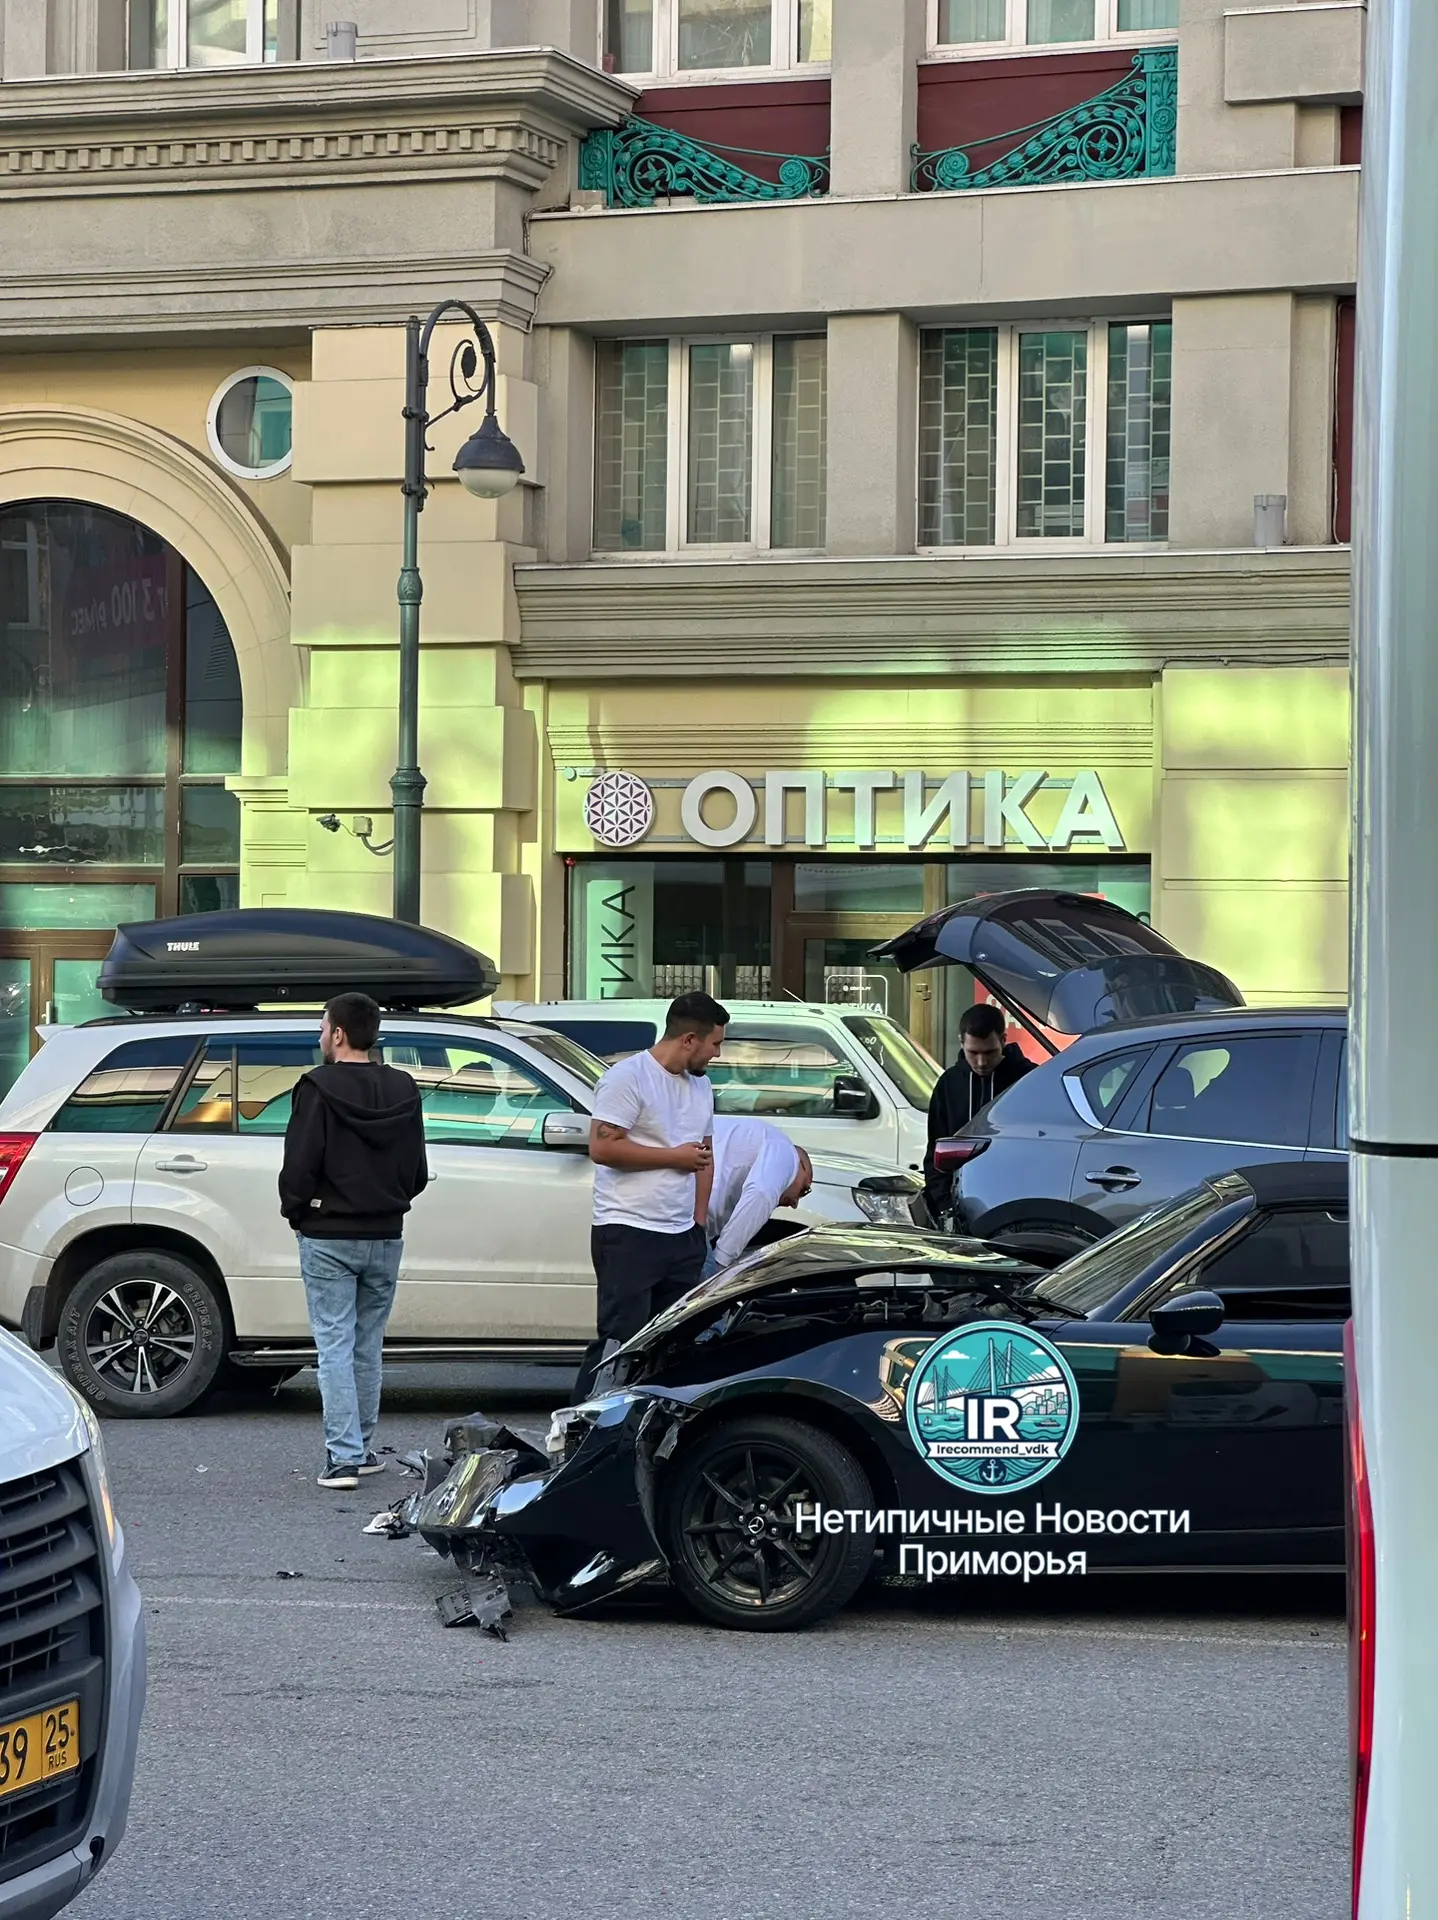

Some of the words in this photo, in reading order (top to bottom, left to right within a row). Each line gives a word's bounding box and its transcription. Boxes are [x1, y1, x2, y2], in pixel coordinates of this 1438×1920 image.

[681, 770, 1126, 849] ОПТИКА
[167, 941, 199, 951] THULE
[183, 1283, 212, 1350] GRIPMAX
[46, 1708, 69, 1754] 25
[48, 1751, 67, 1771] RUS
